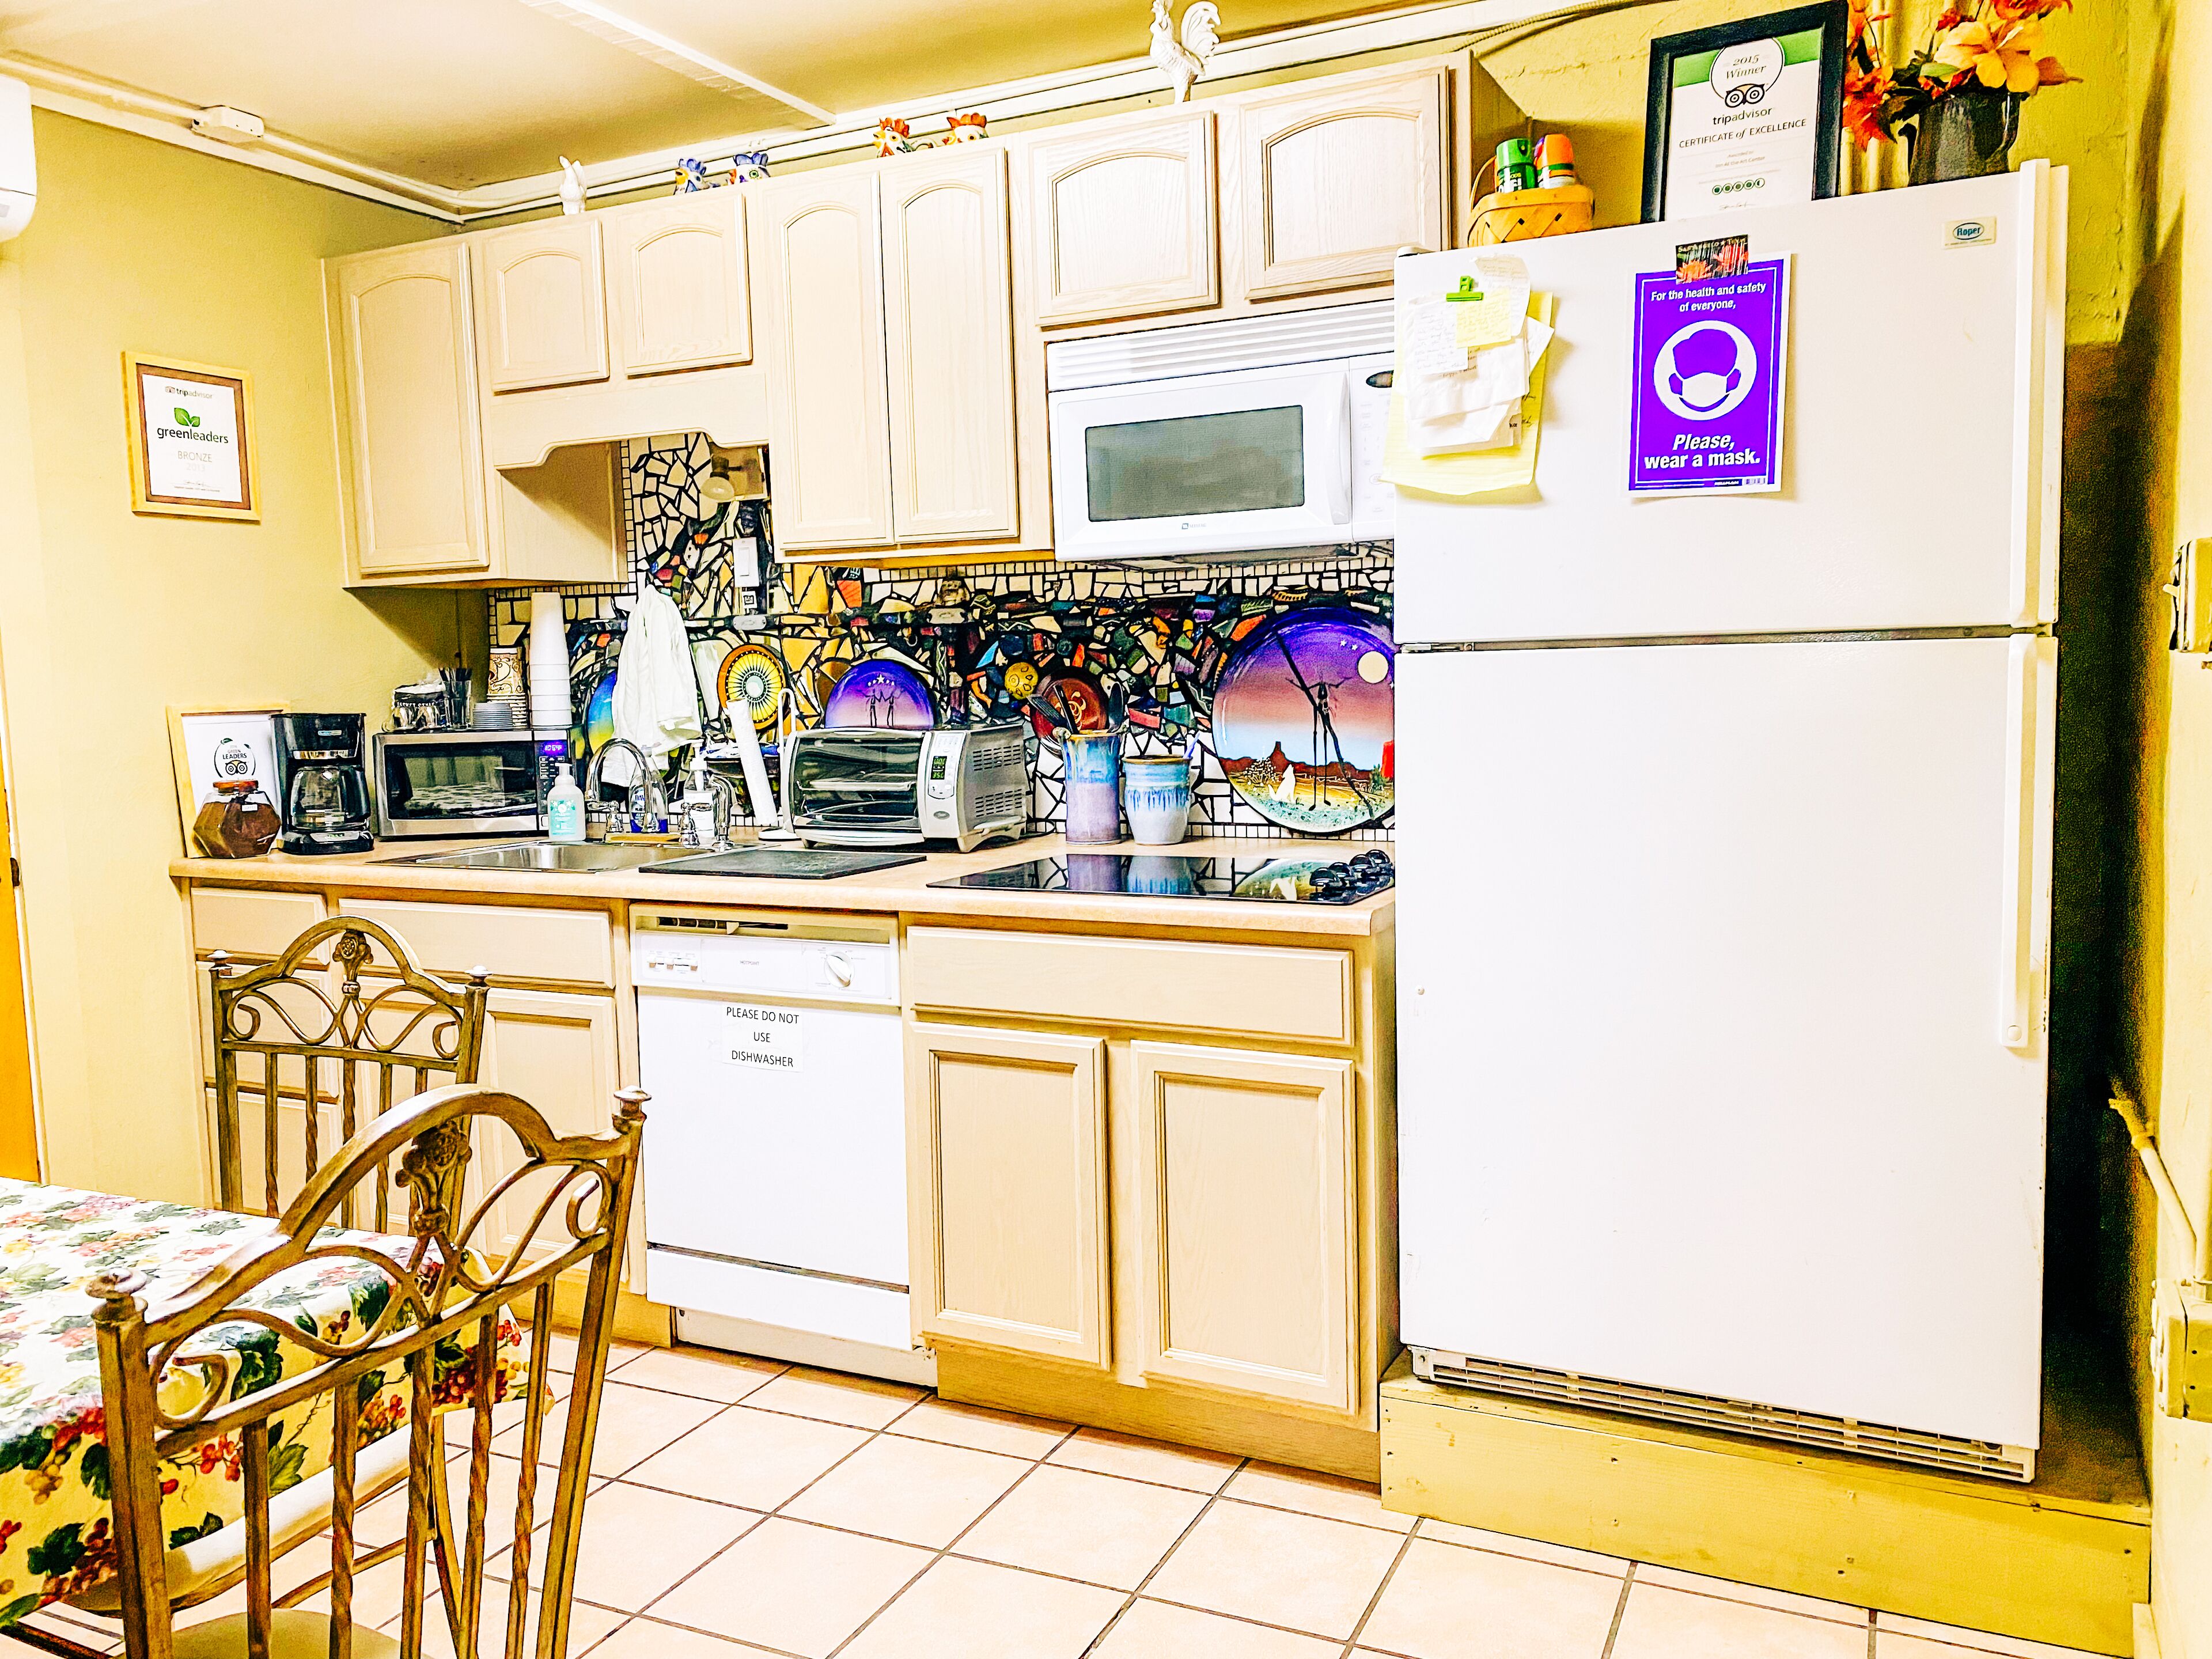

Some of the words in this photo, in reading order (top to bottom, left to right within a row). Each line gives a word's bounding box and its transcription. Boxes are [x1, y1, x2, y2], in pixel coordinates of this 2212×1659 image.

[1733, 55, 1760, 66] 2015
[1726, 66, 1767, 79] Winner
[1713, 108, 1772, 125] tripadvisor
[1679, 132, 1733, 148] CERTIFICATE
[1736, 128, 1747, 139] of
[1749, 119, 1806, 136] EXCELLENCE
[1957, 227, 1980, 236] Roper
[1651, 291, 1666, 301] For
[1668, 289, 1683, 300] the
[1685, 286, 1715, 299] health
[1717, 285, 1735, 296] and
[1736, 282, 1767, 295] safety
[1679, 302, 1690, 312] of
[1691, 300, 1736, 312] everyone,
[176, 387, 213, 399] tripadvisor
[157, 427, 229, 444] greenleaders
[1672, 434, 1735, 451] Please,
[177, 450, 212, 463] BRONZE
[1644, 454, 1689, 469] wear
[1692, 454, 1703, 467] a
[1709, 448, 1760, 467] mask.
[726, 1007, 759, 1020] PLEASE
[762, 1010, 776, 1022] DO
[778, 1013, 799, 1024] NOT
[753, 1032, 771, 1043] USE
[732, 1050, 793, 1067] DISHWASHER
